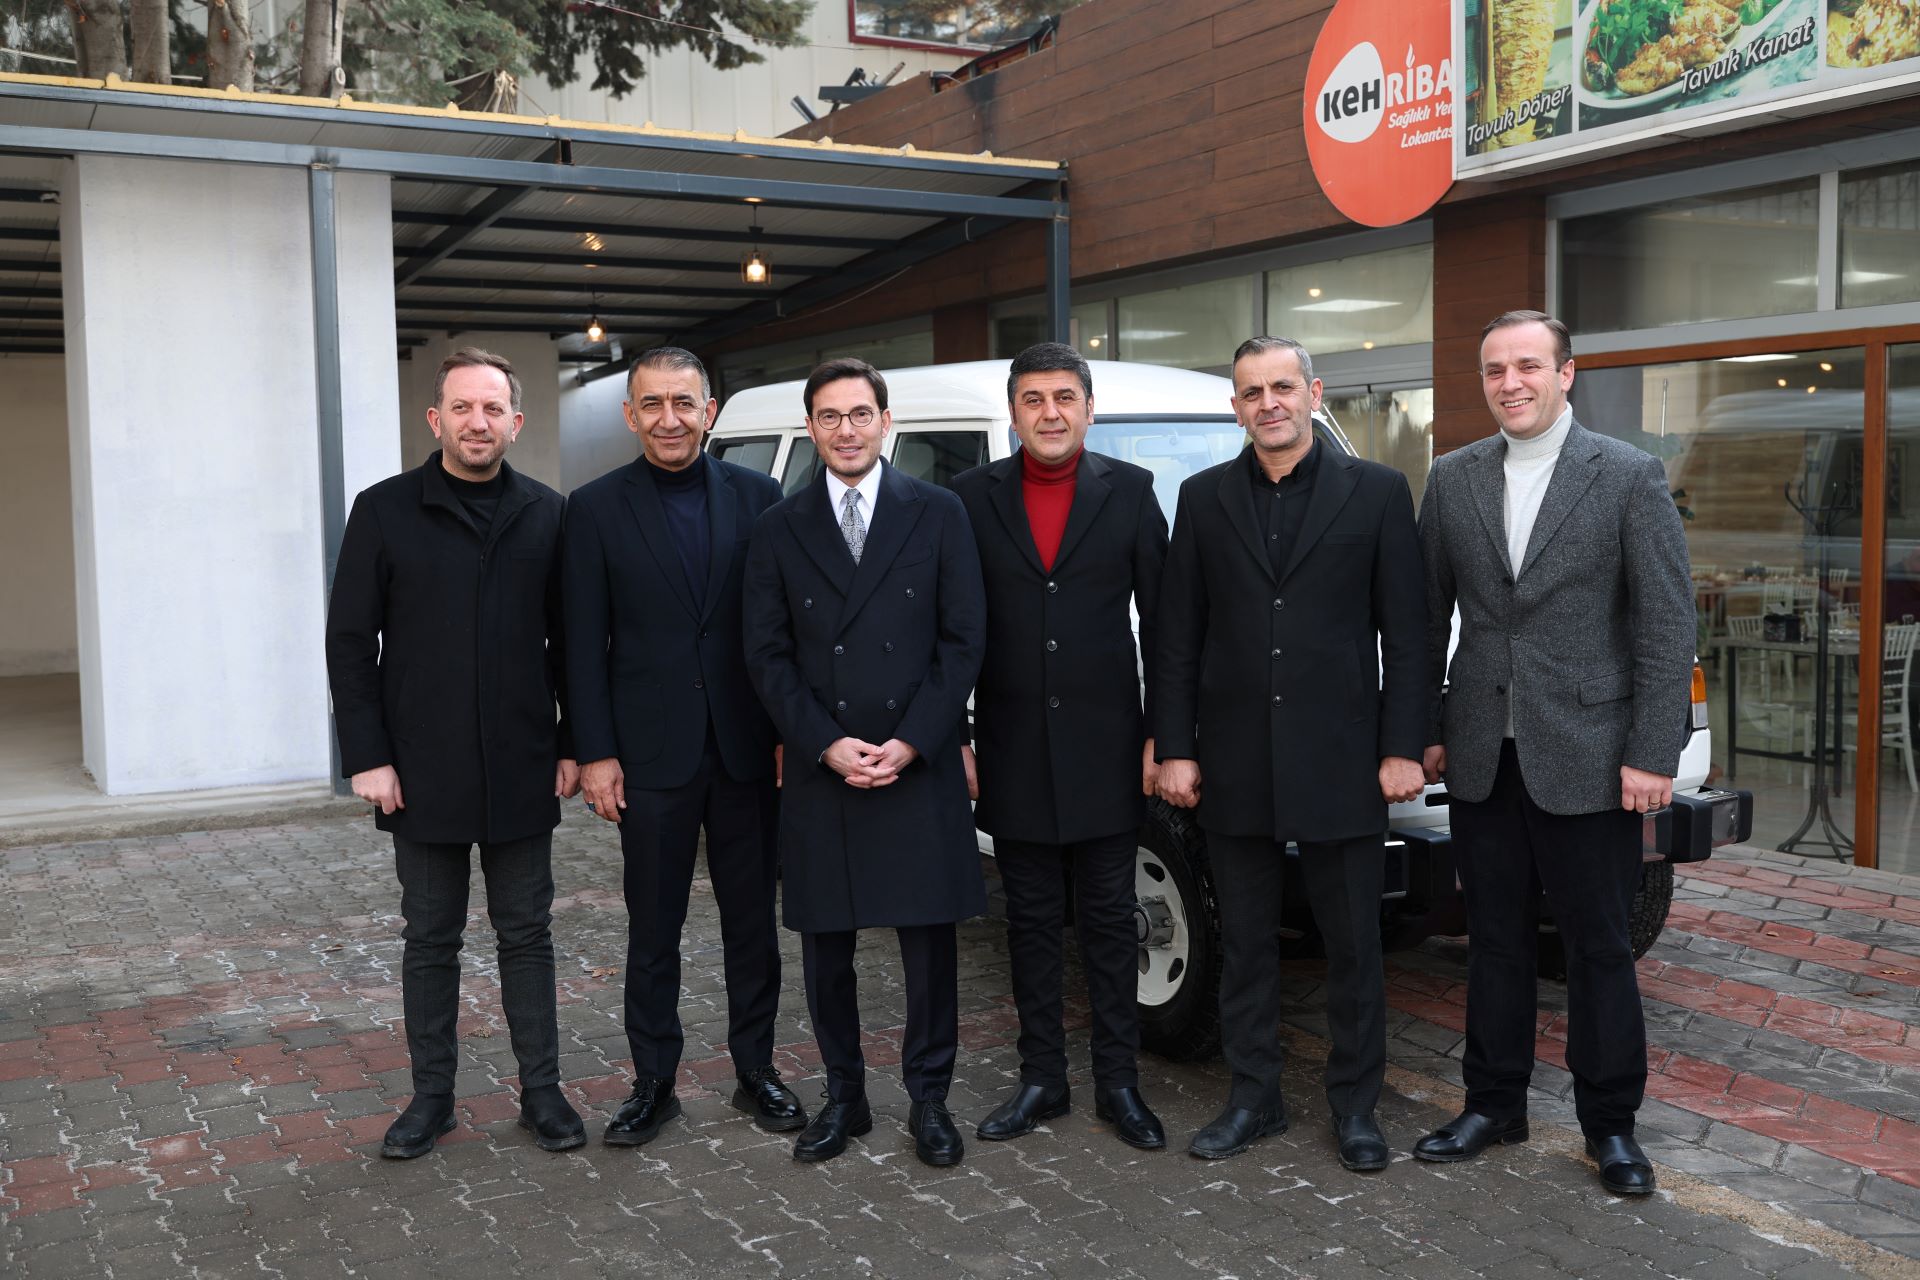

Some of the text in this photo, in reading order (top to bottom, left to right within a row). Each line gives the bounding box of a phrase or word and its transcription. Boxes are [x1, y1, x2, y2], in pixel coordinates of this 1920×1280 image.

[1680, 16, 1815, 94] Tavuk Kanat
[1388, 105, 1431, 129] Sağlıklı
[1467, 84, 1571, 146] Tavuk Döner
